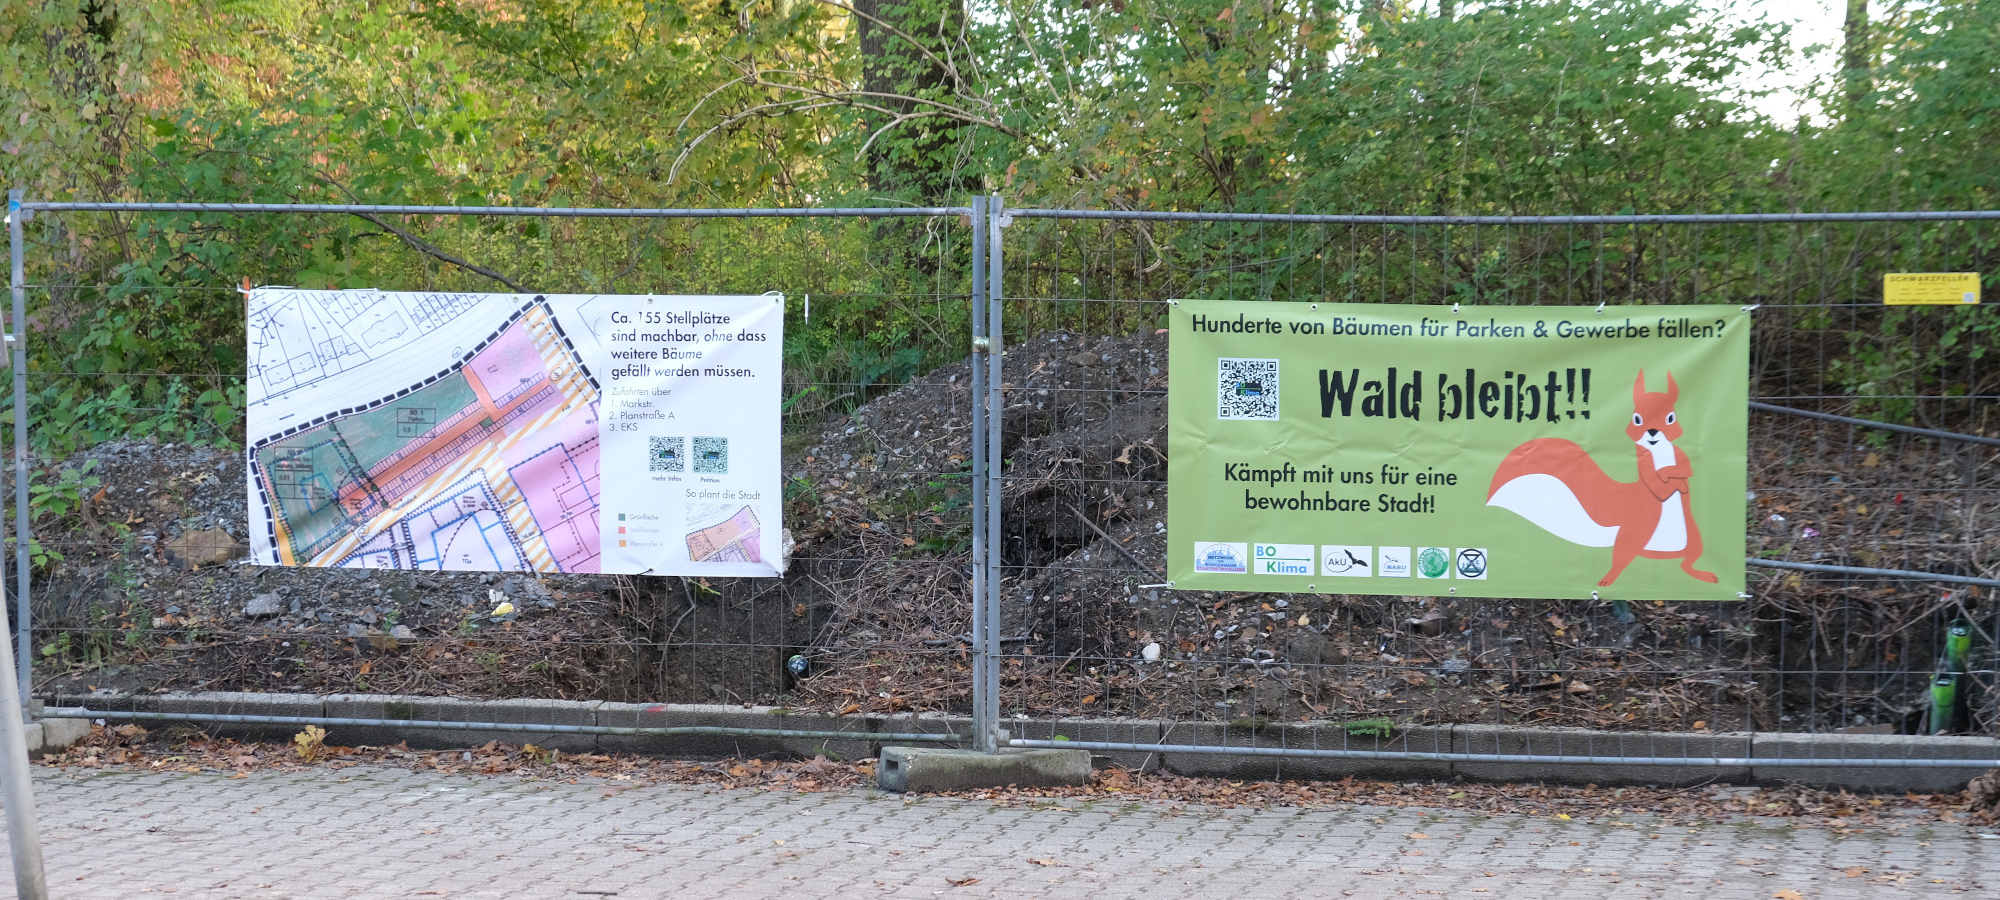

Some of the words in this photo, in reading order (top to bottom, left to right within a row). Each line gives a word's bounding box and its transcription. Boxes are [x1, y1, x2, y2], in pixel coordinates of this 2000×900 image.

[612, 312, 632, 324] Ca.
[638, 312, 661, 324] 155
[666, 311, 730, 327] Stellplätze
[1192, 314, 1282, 334] Hunderte
[1289, 320, 1324, 334] von
[1332, 318, 1412, 336] Bäumen
[1420, 318, 1449, 336] für
[1456, 318, 1524, 338] Parken
[1534, 320, 1548, 338] &
[1556, 318, 1650, 338] Gewerbe
[1658, 318, 1726, 338] fällen?
[612, 329, 636, 342] sind
[642, 329, 700, 344] machbar,
[704, 330, 732, 342] ohne
[738, 329, 766, 342] dass
[612, 348, 658, 360] weitere
[662, 348, 702, 360] Bäume
[612, 364, 650, 380] gefällt
[654, 364, 700, 377] werden
[704, 365, 755, 378] müssen.
[612, 386, 648, 396] Zufahrten
[652, 388, 672, 396] über
[1319, 367, 1422, 421] Wald
[1438, 368, 1591, 423] bleibt!!
[620, 400, 654, 408] Markstr.
[609, 412, 617, 420] 2.
[620, 410, 666, 420] Planstraße
[668, 412, 676, 420] A
[609, 424, 618, 432] 3.
[621, 423, 638, 432] EKS
[1224, 462, 1296, 487] Kämpft
[1303, 464, 1334, 483] mit
[1340, 470, 1374, 484] uns
[1381, 464, 1409, 485] für
[1416, 467, 1458, 486] eine
[686, 488, 696, 498] So
[700, 489, 720, 500] plant
[722, 490, 736, 500] die
[738, 490, 760, 500] Stadt
[1246, 489, 1370, 512] bewohnbare
[1378, 493, 1435, 513] Stadt!
[1256, 546, 1276, 557] BO
[1267, 561, 1307, 574] Klima
[1328, 558, 1347, 566] AkU
